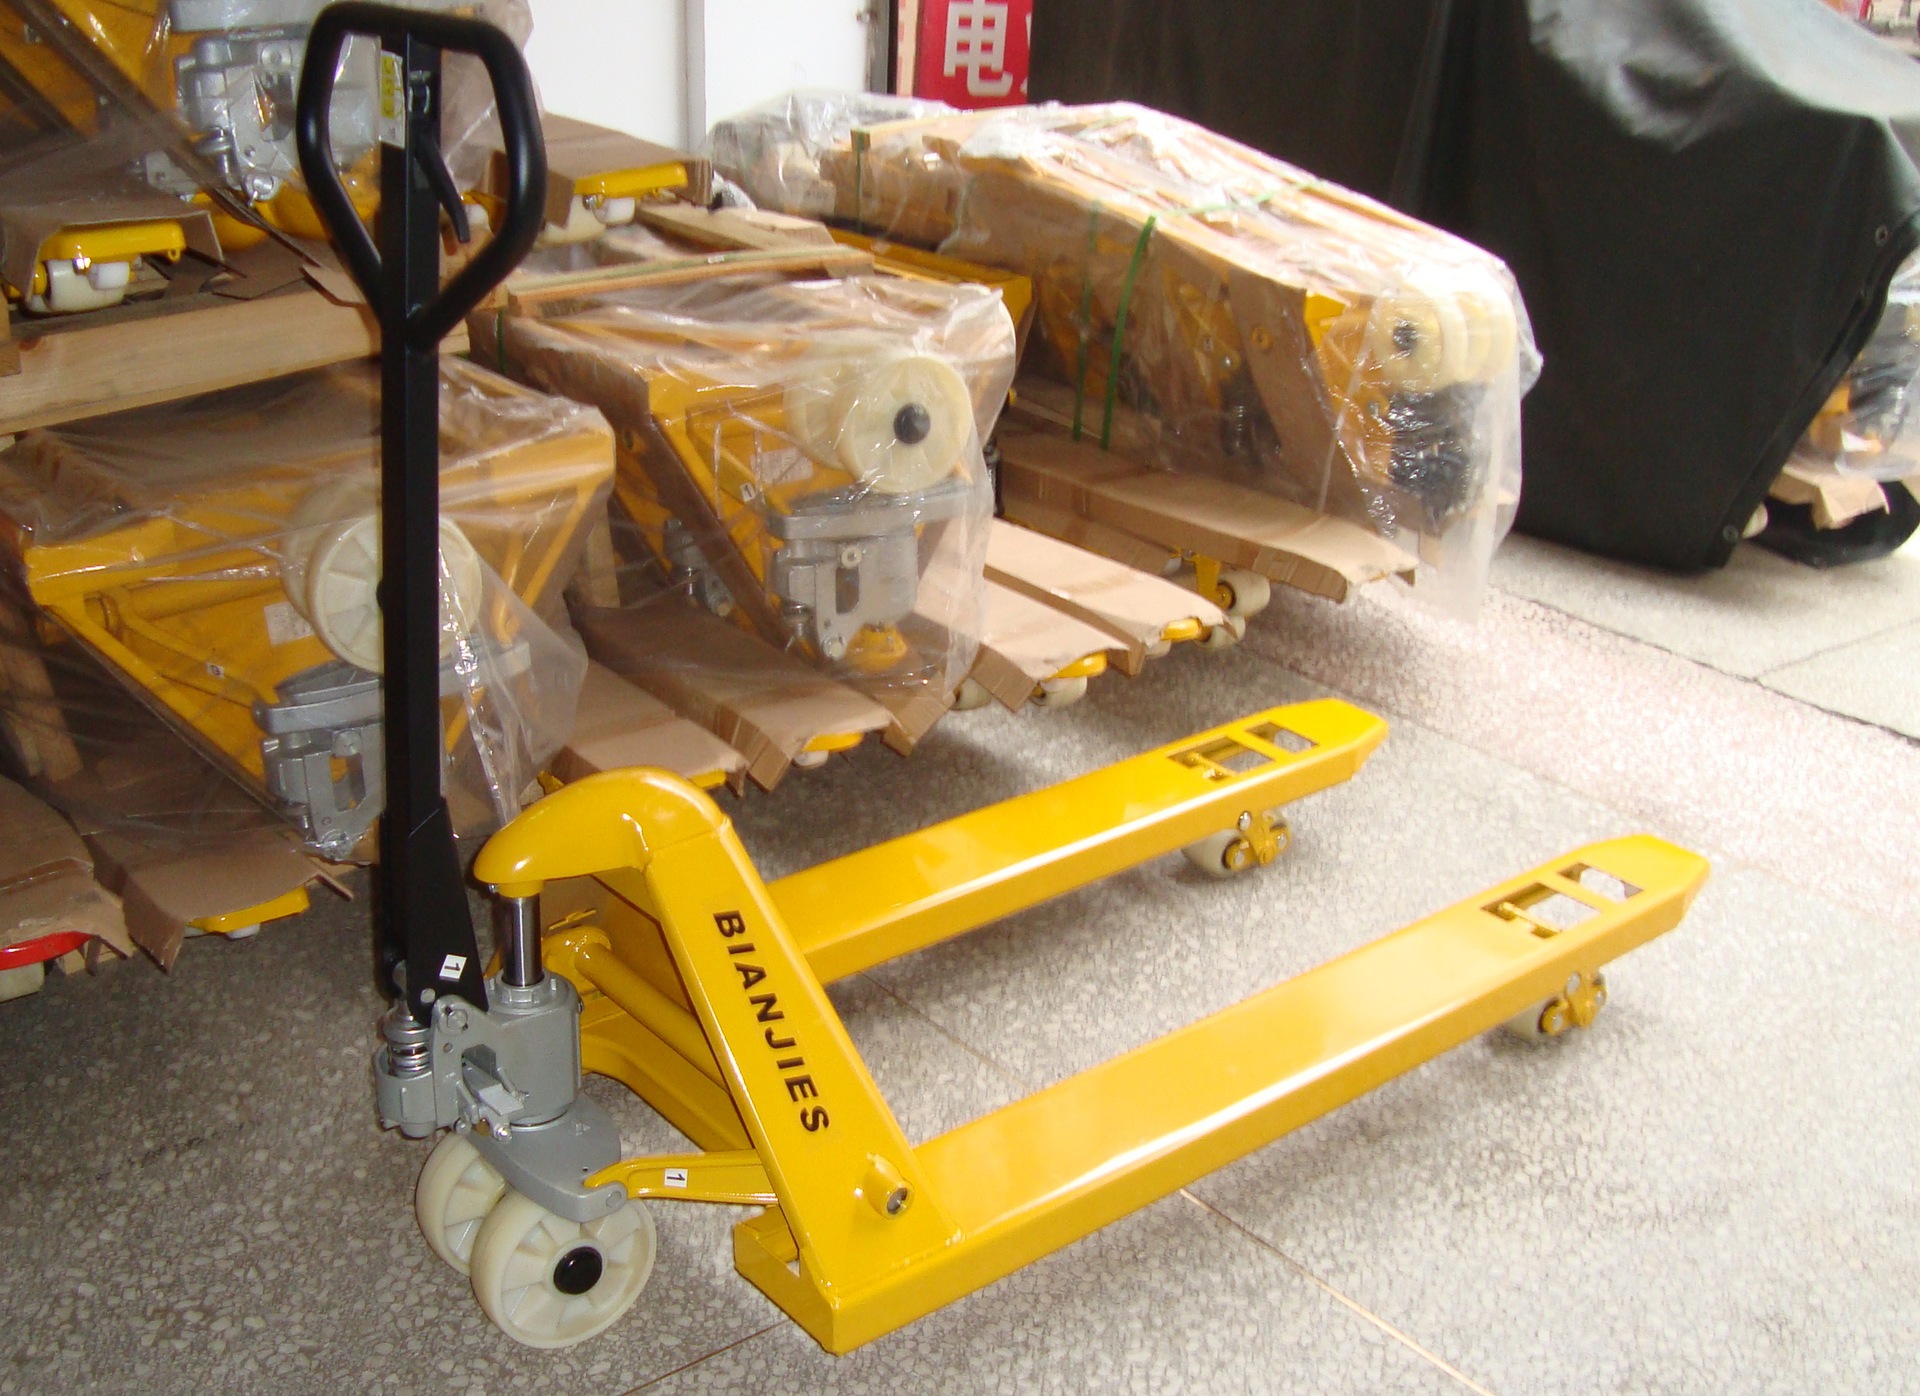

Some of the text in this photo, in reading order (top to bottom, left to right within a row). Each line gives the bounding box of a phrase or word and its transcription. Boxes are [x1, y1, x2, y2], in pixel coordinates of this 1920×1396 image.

[943, 0, 1033, 97] 电
[444, 962, 461, 972] 1
[713, 910, 830, 1133] BIANJIES
[666, 1173, 686, 1182] 1
